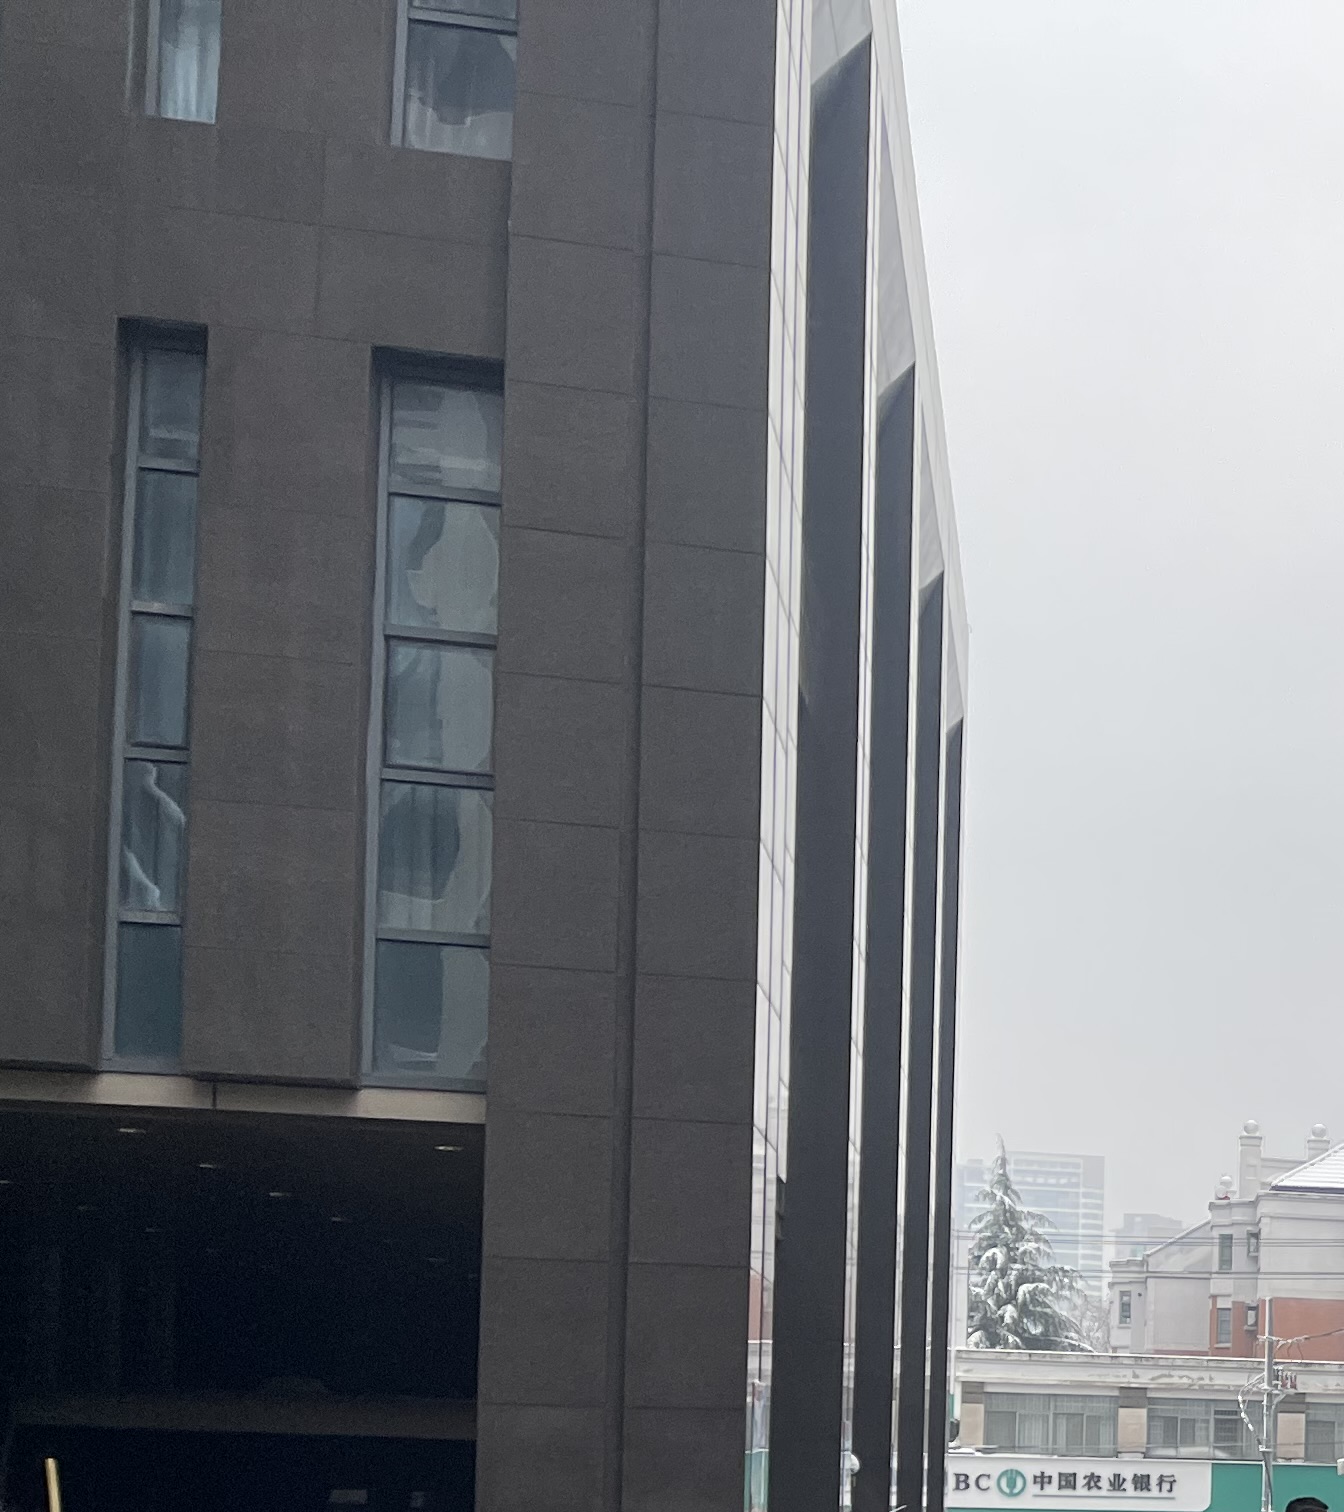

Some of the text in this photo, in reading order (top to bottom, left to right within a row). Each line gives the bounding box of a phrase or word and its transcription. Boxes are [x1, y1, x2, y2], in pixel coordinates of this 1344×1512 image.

[1032, 1470, 1177, 1494] 中国农业银行
